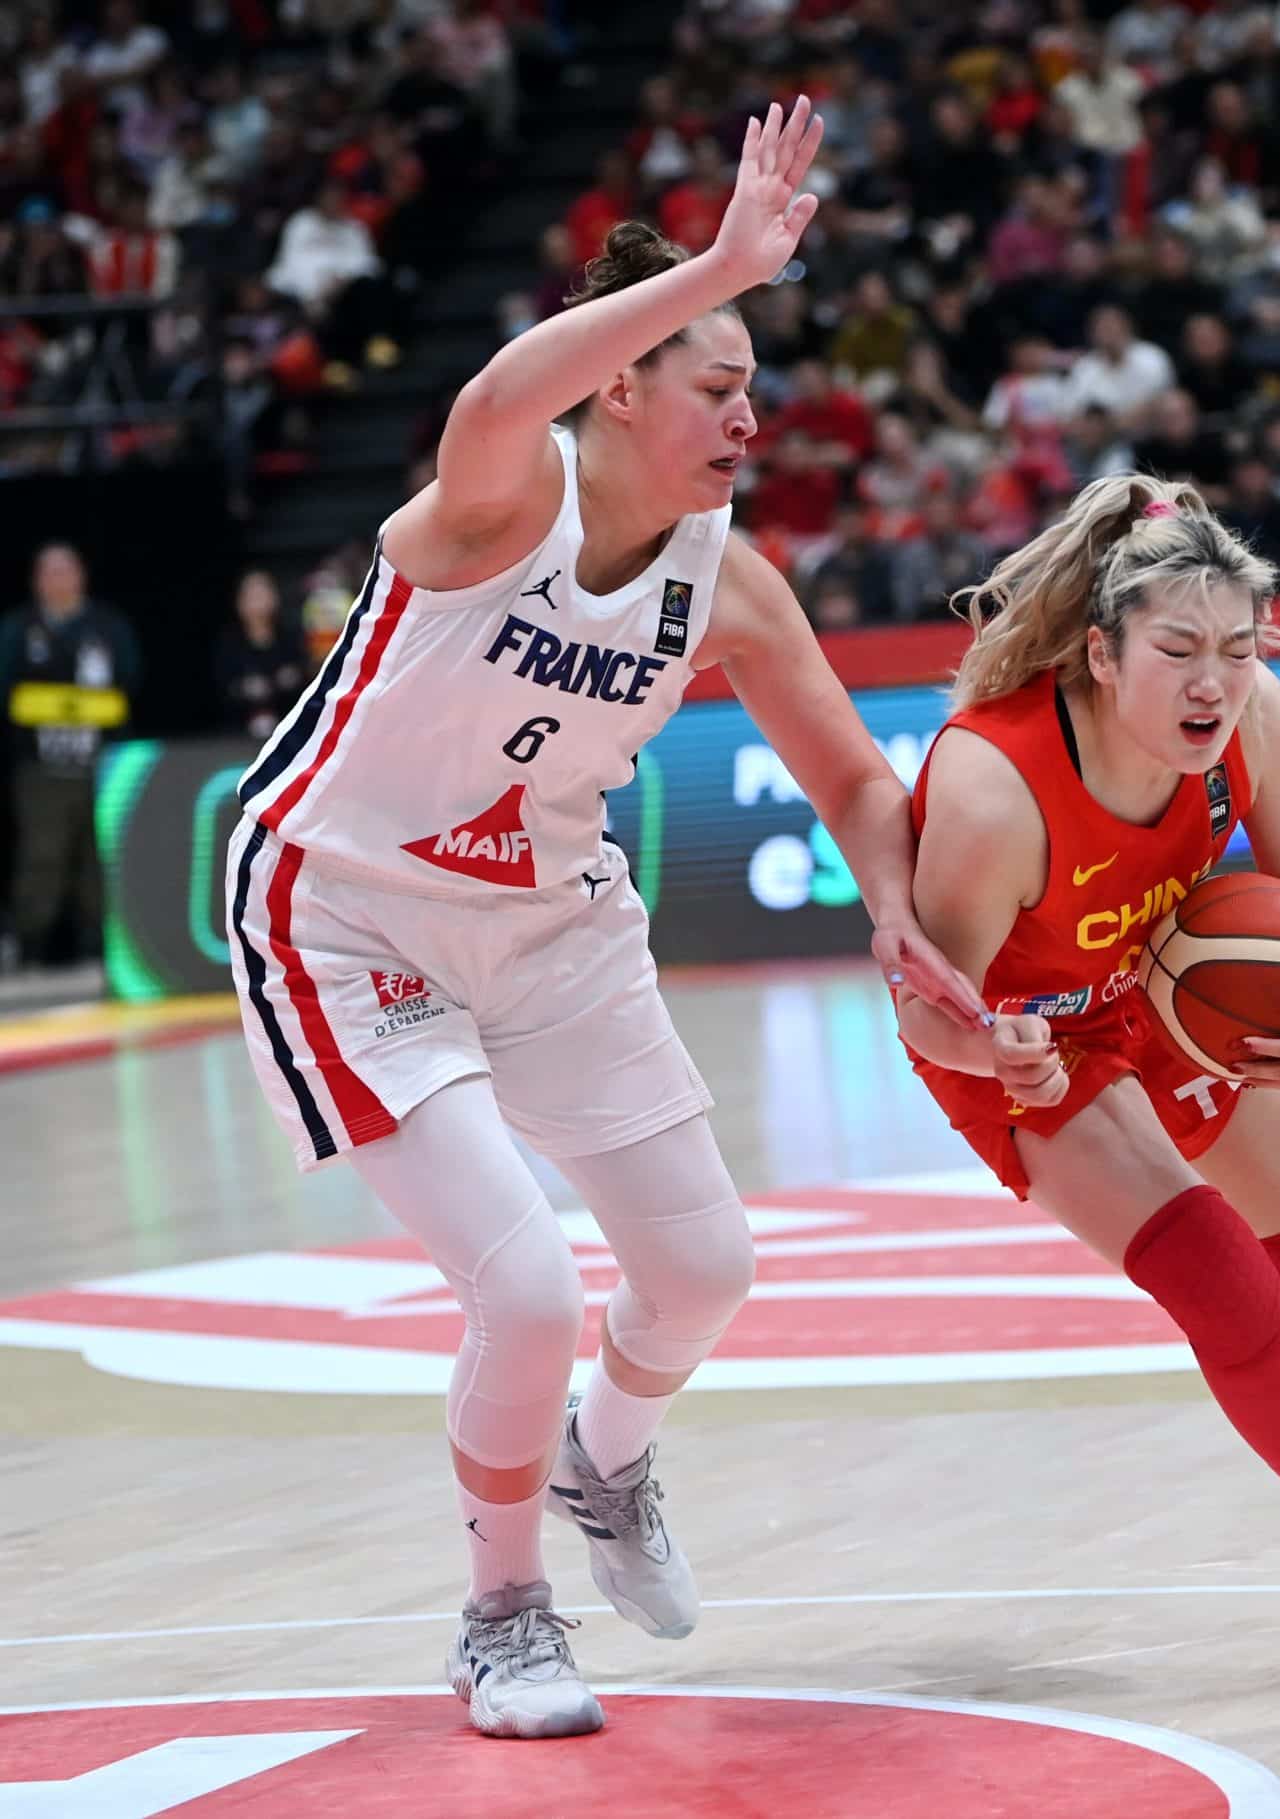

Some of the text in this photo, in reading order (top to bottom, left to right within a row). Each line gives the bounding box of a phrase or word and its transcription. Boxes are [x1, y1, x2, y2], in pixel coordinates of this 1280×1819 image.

[663, 622, 685, 638] FIBA
[484, 613, 668, 705] FRANCE
[502, 716, 561, 764] 6
[432, 830, 530, 864] MAIF
[1076, 868, 1201, 950] CHIN
[375, 1007, 446, 1038] D'EPARGNE
[384, 998, 430, 1017] CAISSE
